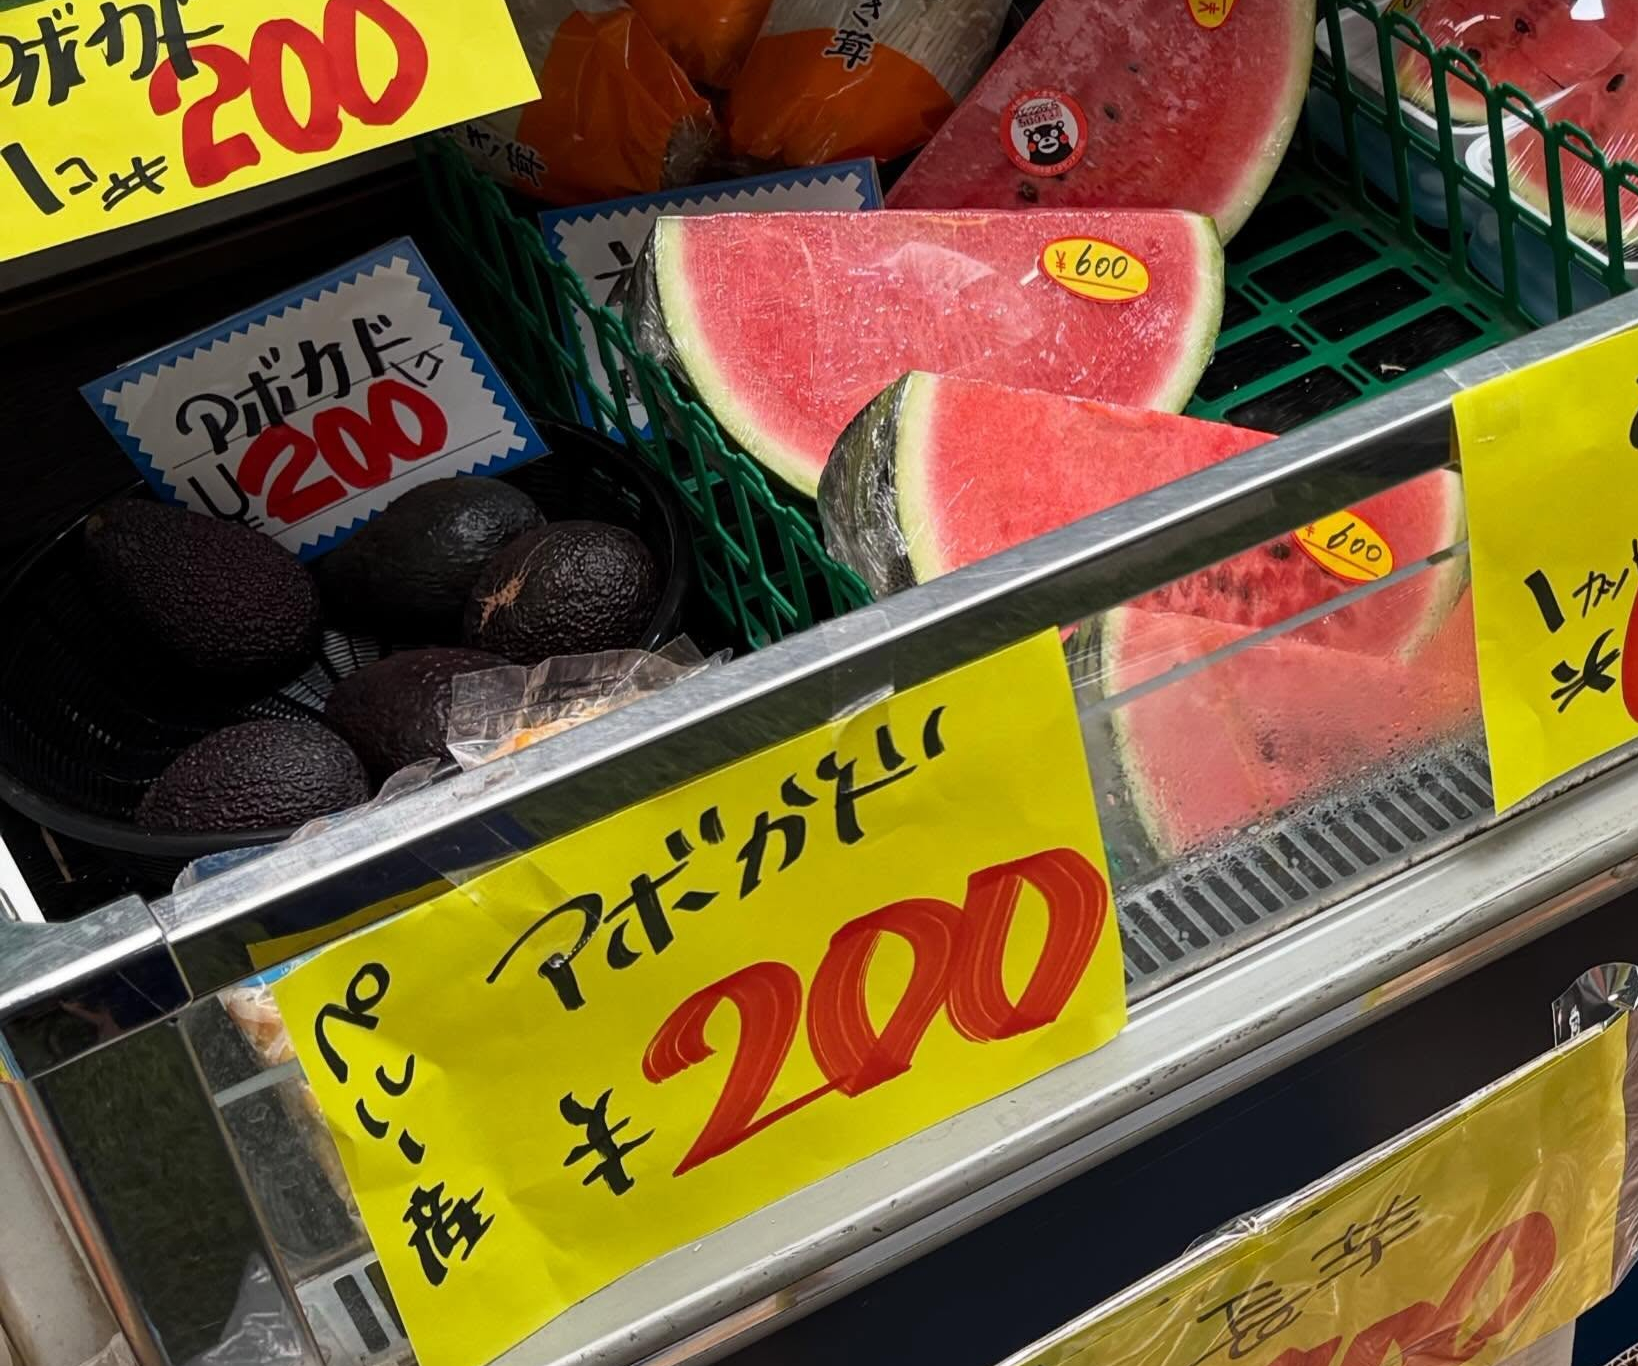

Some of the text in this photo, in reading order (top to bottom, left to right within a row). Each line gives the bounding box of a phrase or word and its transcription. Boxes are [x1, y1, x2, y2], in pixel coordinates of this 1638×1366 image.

[175, 313, 413, 456] アボカド
[558, 847, 1109, 1197] ¥200
